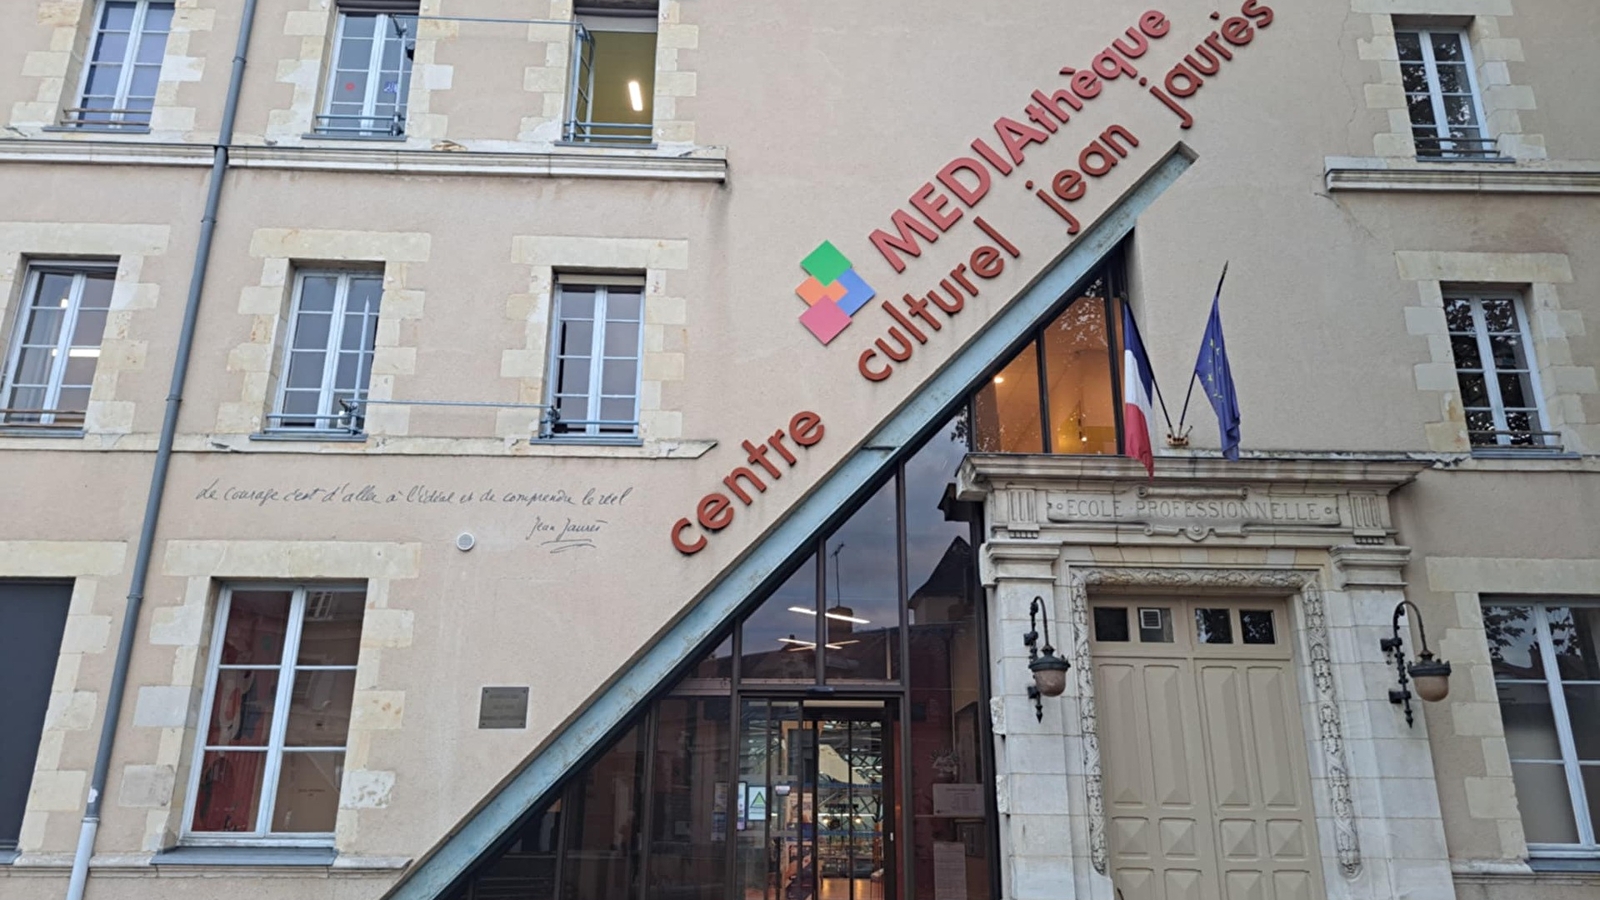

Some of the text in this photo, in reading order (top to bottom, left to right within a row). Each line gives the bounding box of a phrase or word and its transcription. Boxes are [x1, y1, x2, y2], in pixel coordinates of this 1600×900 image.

[868, 9, 1171, 275] MEDIAthèque
[671, 0, 1275, 556] centre culturel jean jaurès
[479, 489, 497, 502] de
[581, 487, 594, 505] le
[1067, 500, 1321, 520] ECOLE PROFESSIONNELLE
